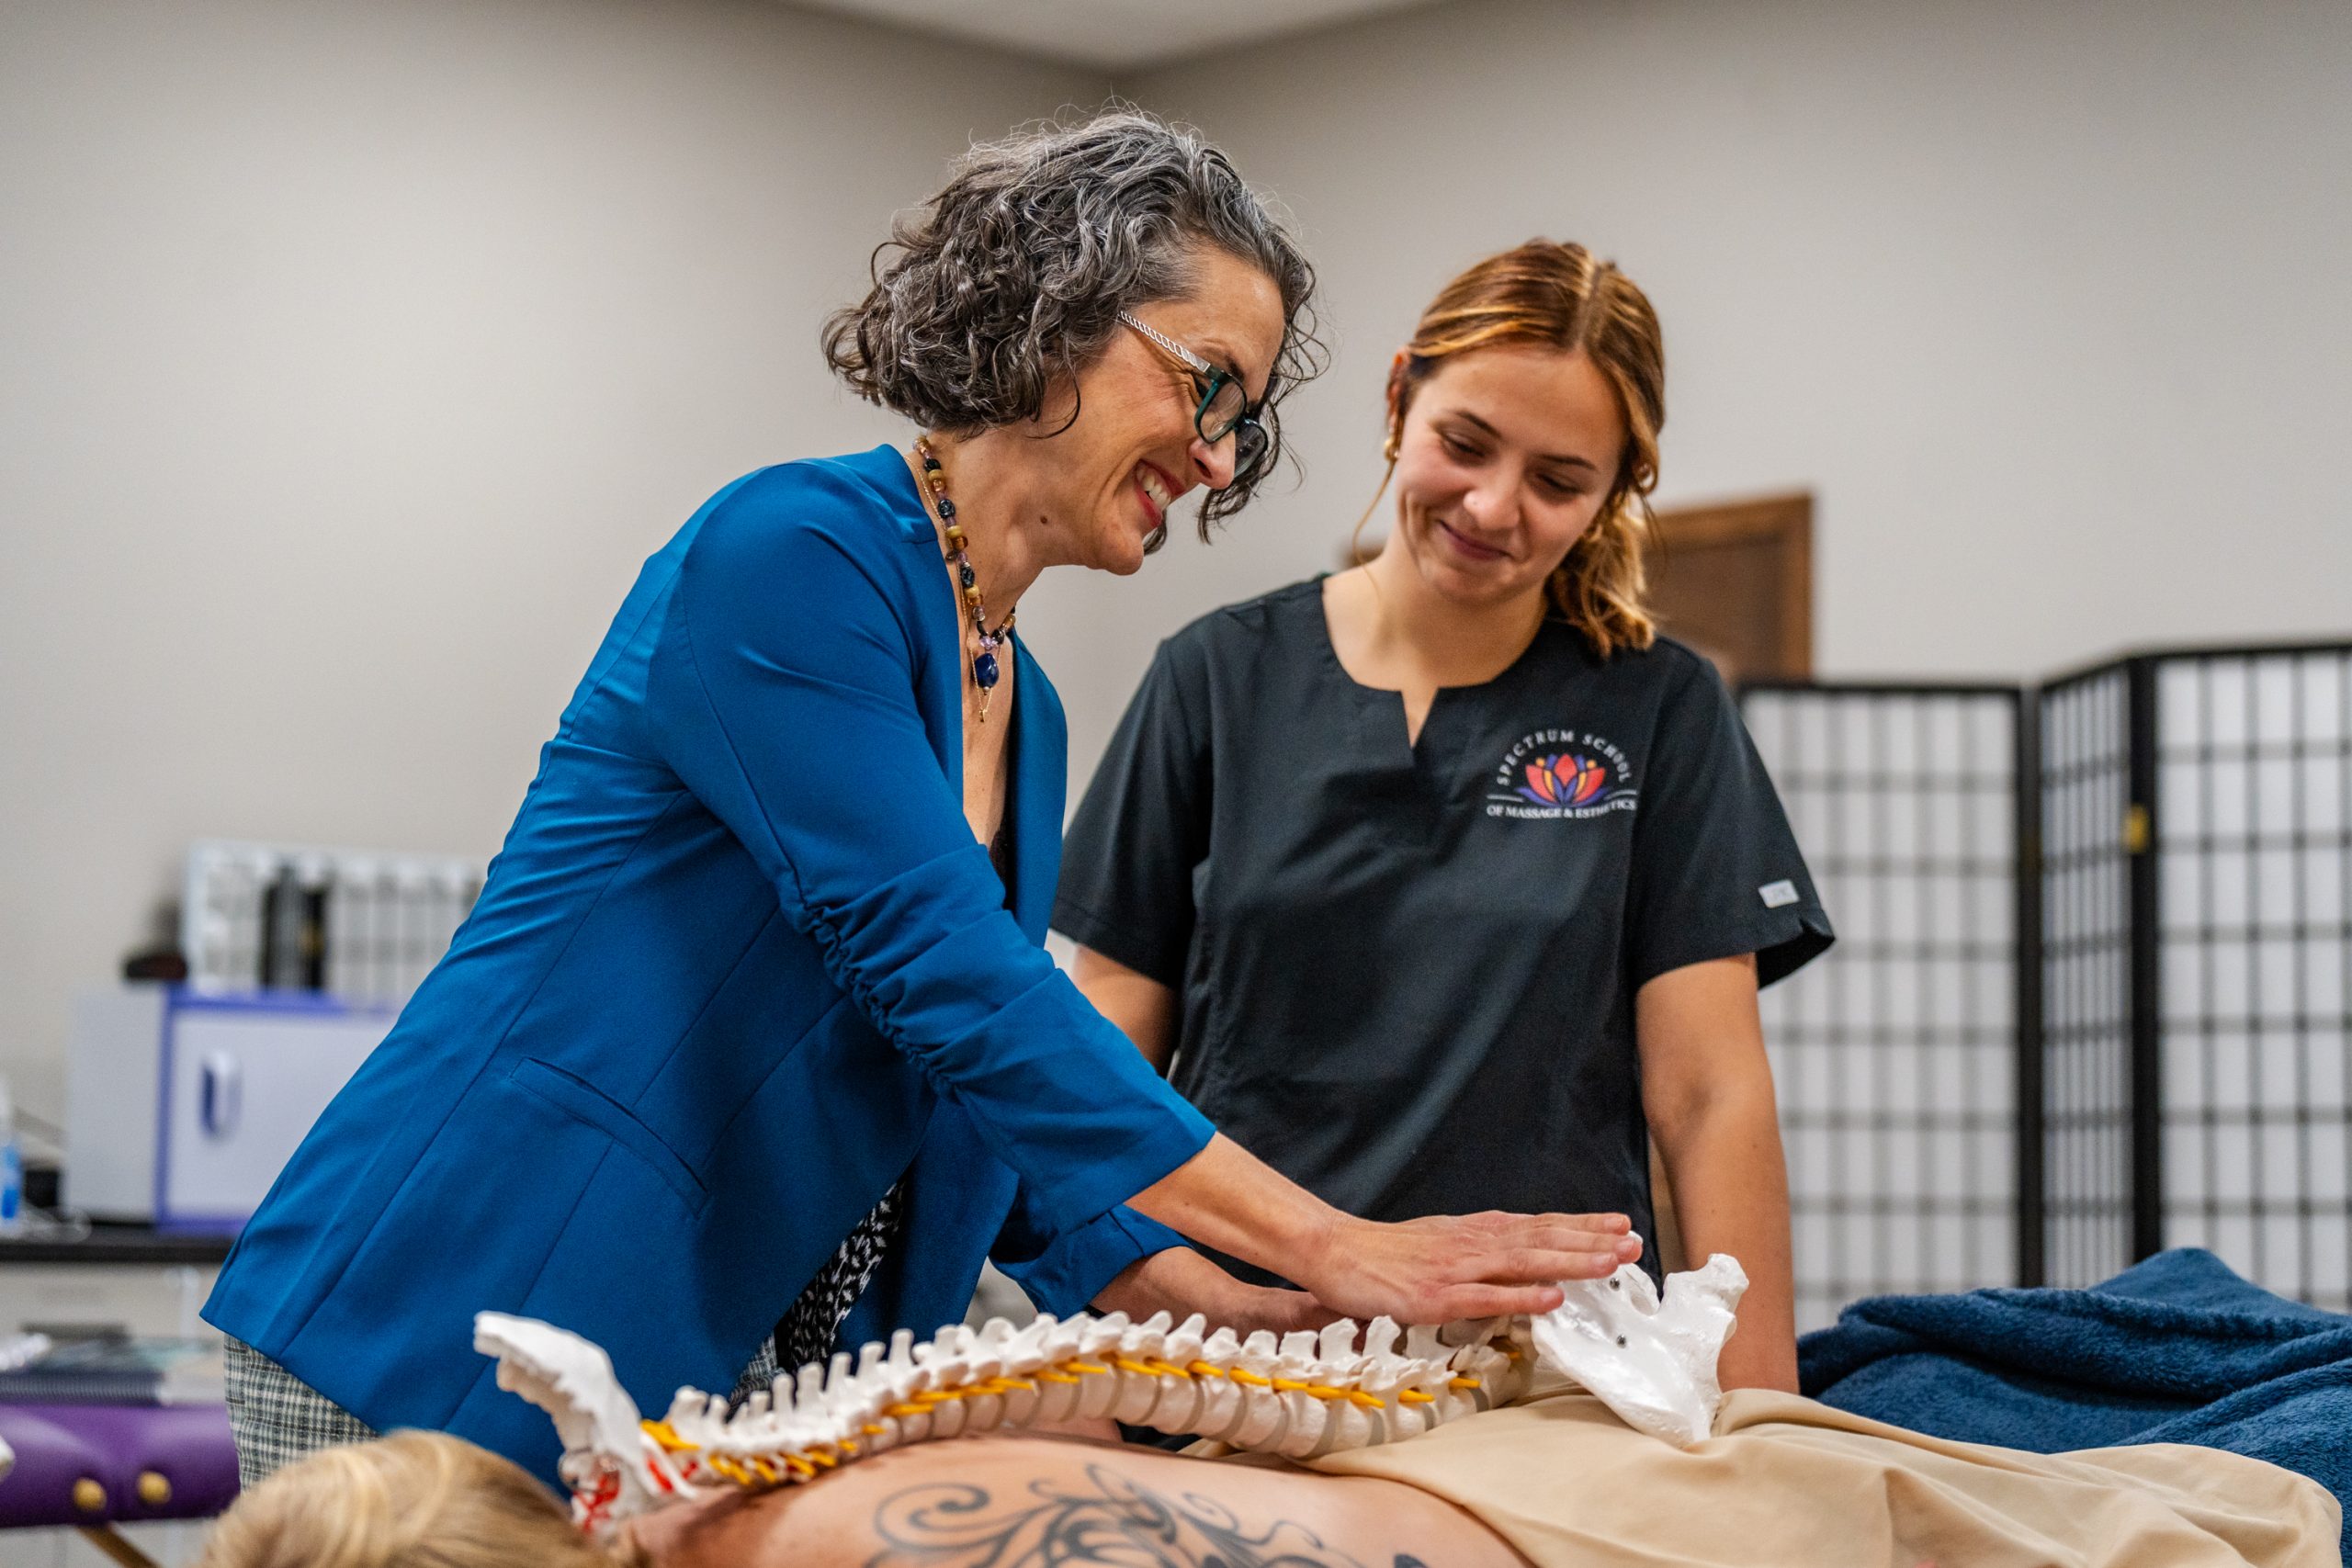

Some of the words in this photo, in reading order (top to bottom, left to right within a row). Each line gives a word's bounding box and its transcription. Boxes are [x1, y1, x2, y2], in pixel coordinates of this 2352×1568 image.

[1497, 728, 1575, 786] SPECTRUM
[1582, 734, 1632, 783] SCHOOL
[1487, 805, 1503, 817] OF
[1505, 807, 1562, 818] MASSAGE
[1563, 808, 1573, 818] &
[1576, 798, 1637, 818] ESTHETICS
